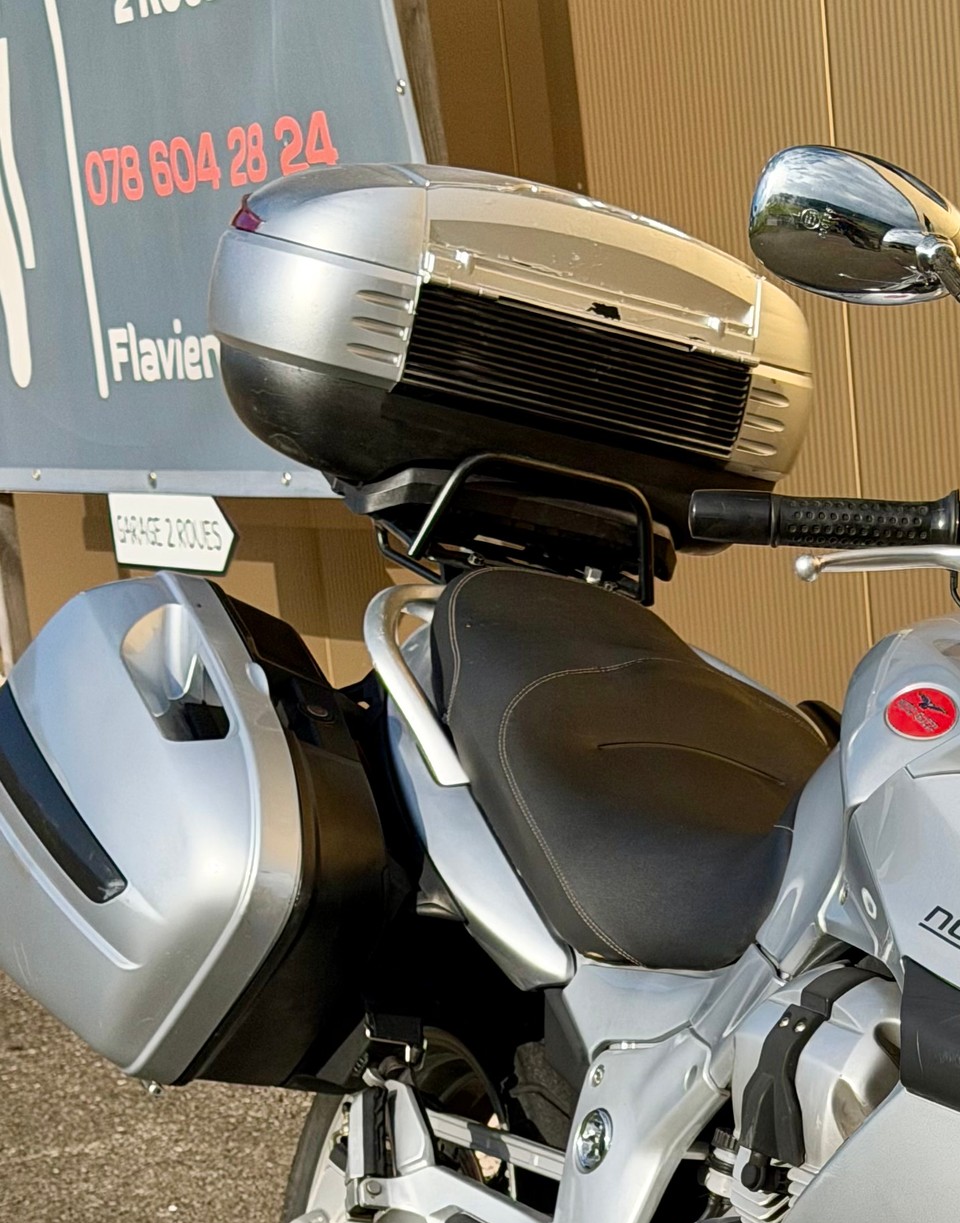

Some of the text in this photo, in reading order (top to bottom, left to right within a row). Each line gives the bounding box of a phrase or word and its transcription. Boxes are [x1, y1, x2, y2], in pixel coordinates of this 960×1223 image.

[85, 110, 339, 206] 078 604 28 24
[107, 318, 220, 382] Flavien
[165, 518, 175, 547] 2
[176, 519, 222, 550] ROUES
